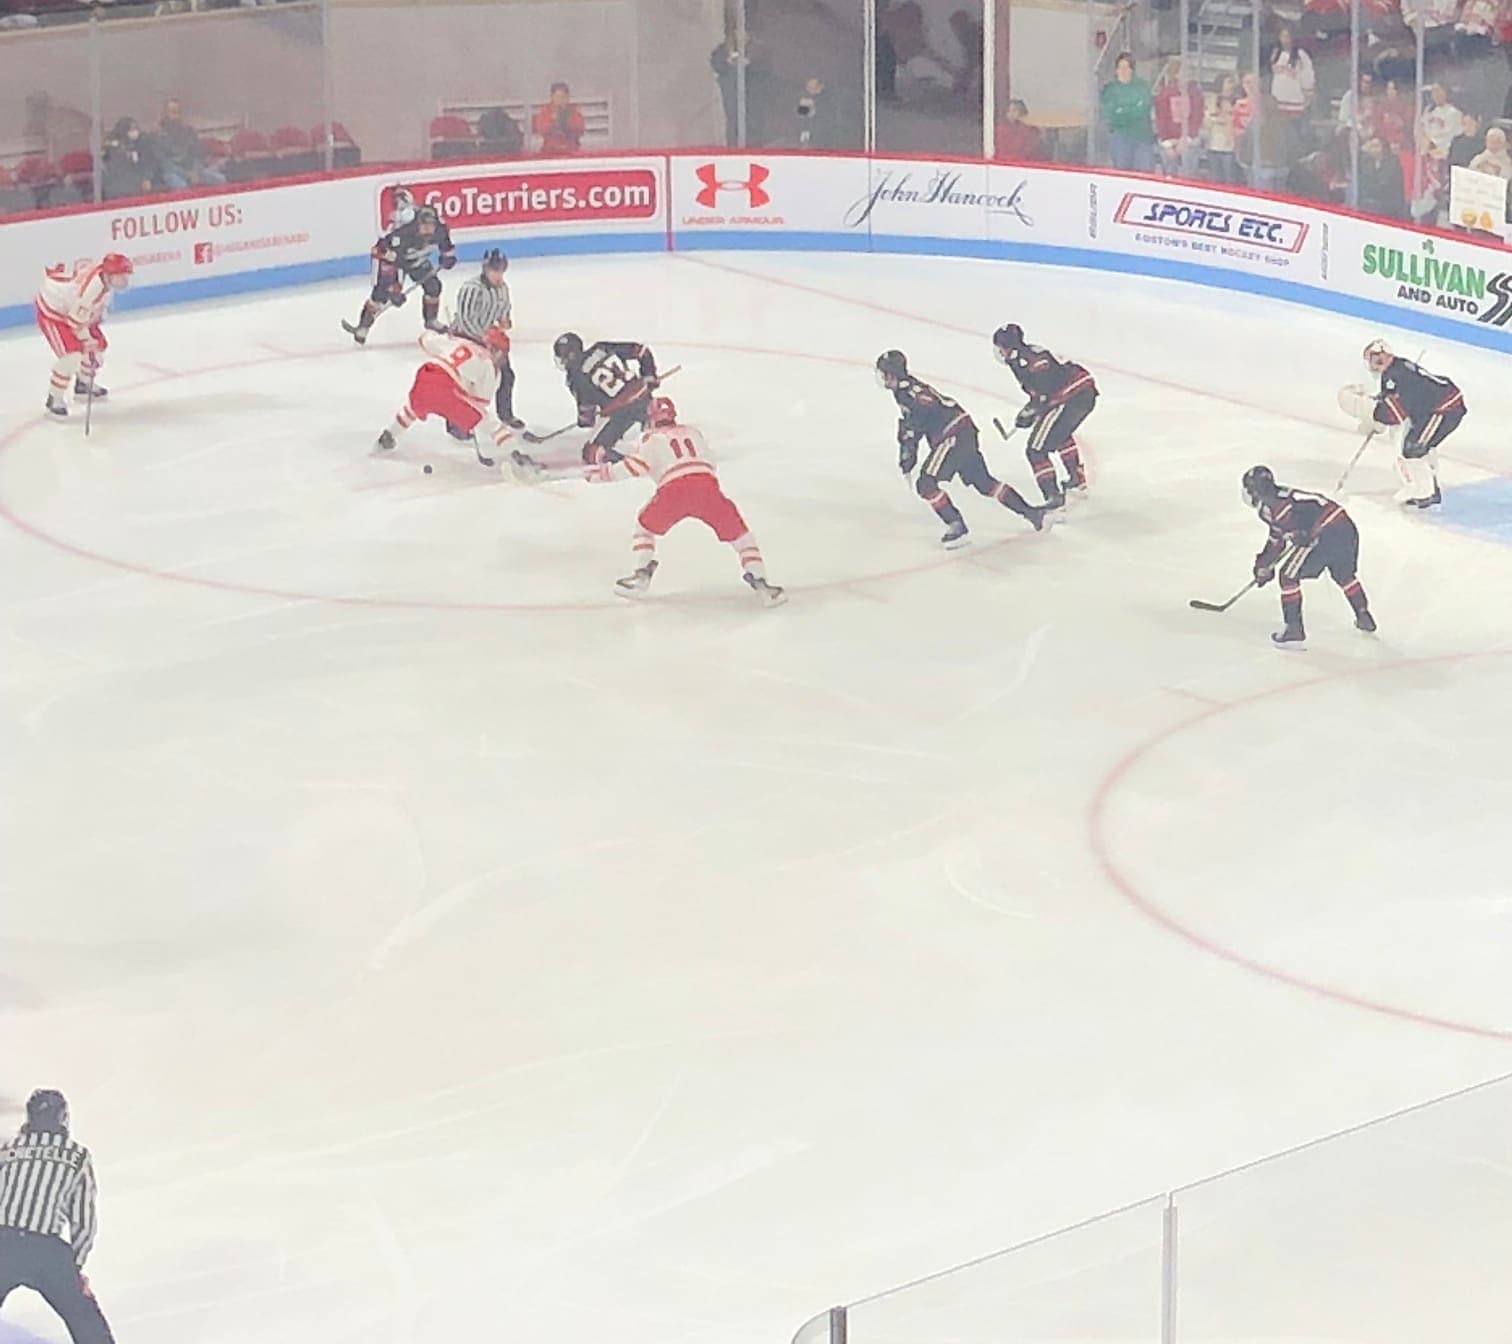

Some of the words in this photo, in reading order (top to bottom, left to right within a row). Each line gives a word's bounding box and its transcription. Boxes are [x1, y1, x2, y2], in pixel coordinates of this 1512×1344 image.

[424, 182, 650, 218] GoTerriers.com
[843, 167, 919, 228] John
[921, 168, 1034, 228] Hancock
[111, 209, 199, 241] FOLLOW
[209, 204, 243, 227] US:
[1143, 203, 1232, 234] SPORTS
[1238, 217, 1284, 244] ETC.
[1362, 243, 1486, 300] SULLIVAN
[1397, 284, 1432, 304] AND
[1436, 294, 1479, 316] AUTO
[669, 437, 697, 460] 11
